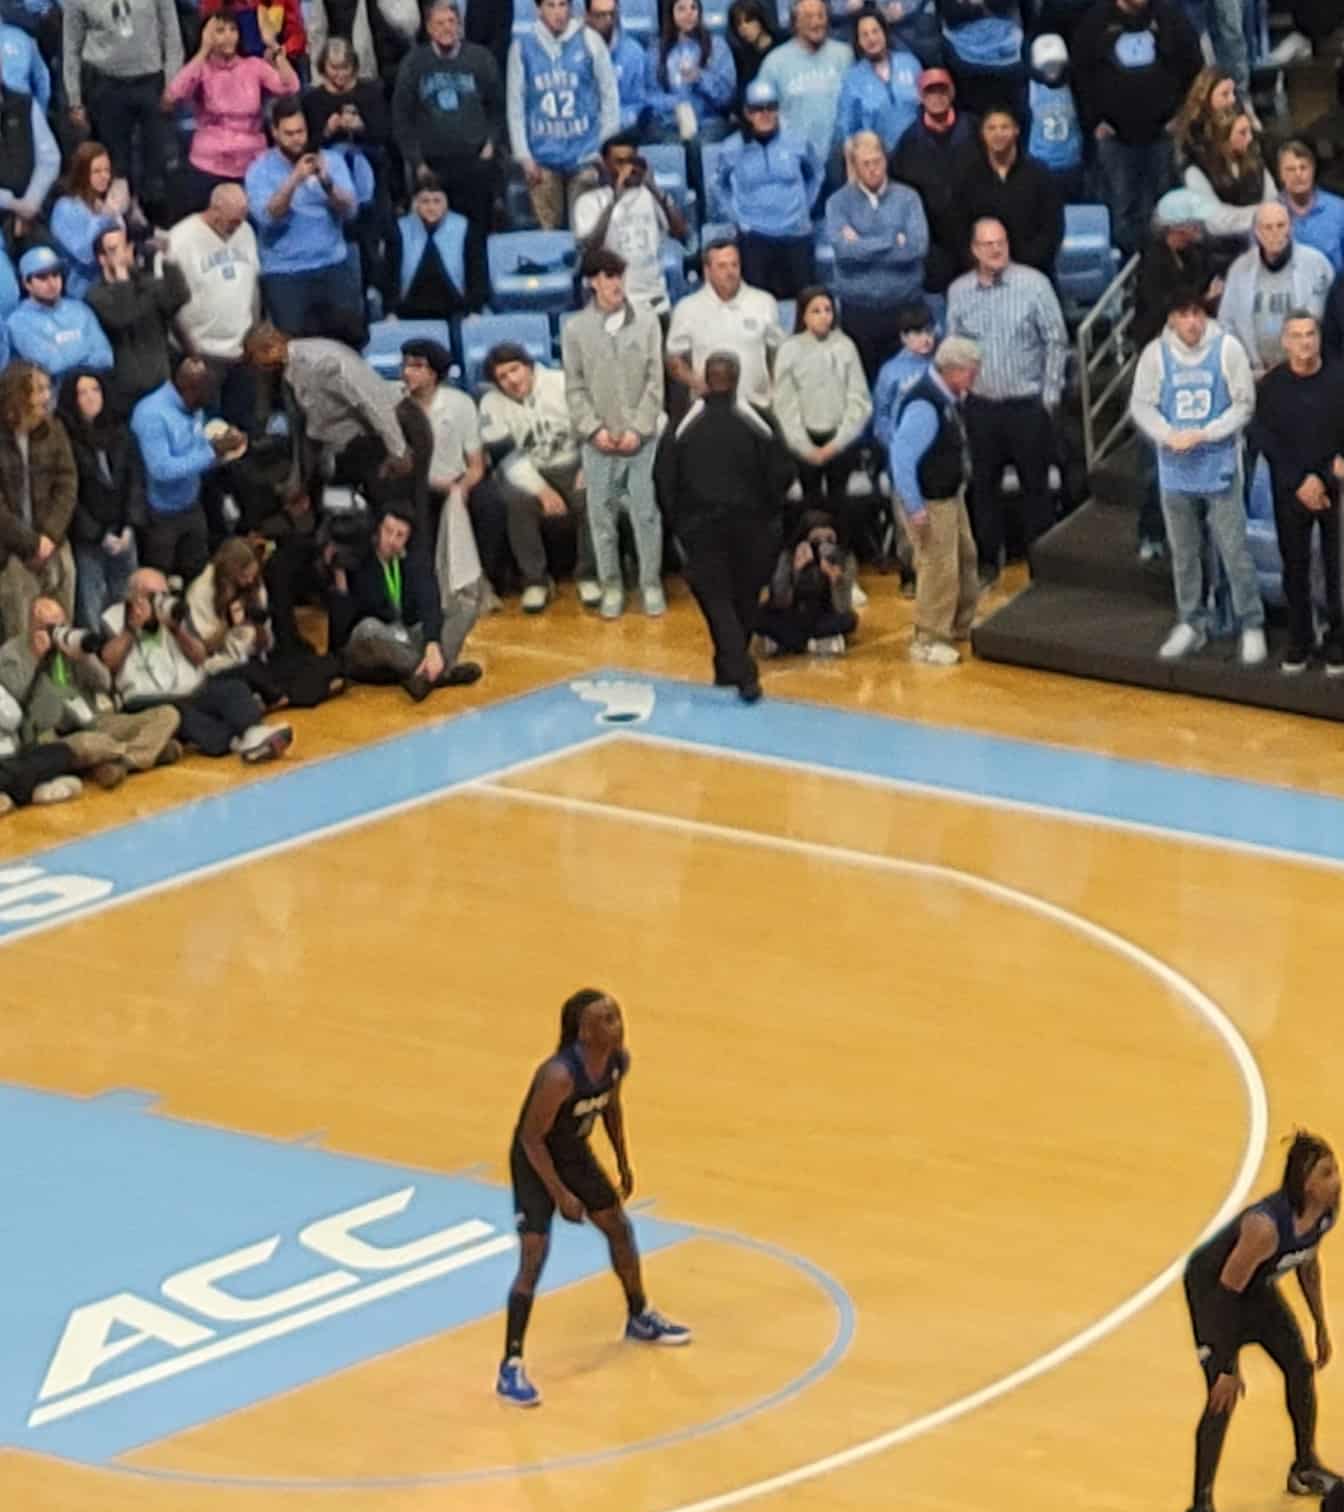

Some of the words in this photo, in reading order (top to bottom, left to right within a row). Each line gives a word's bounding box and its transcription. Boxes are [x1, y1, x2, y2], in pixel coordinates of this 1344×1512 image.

[541, 90, 575, 118] 42
[1175, 388, 1212, 420] 23
[37, 1186, 497, 1401] ACC
